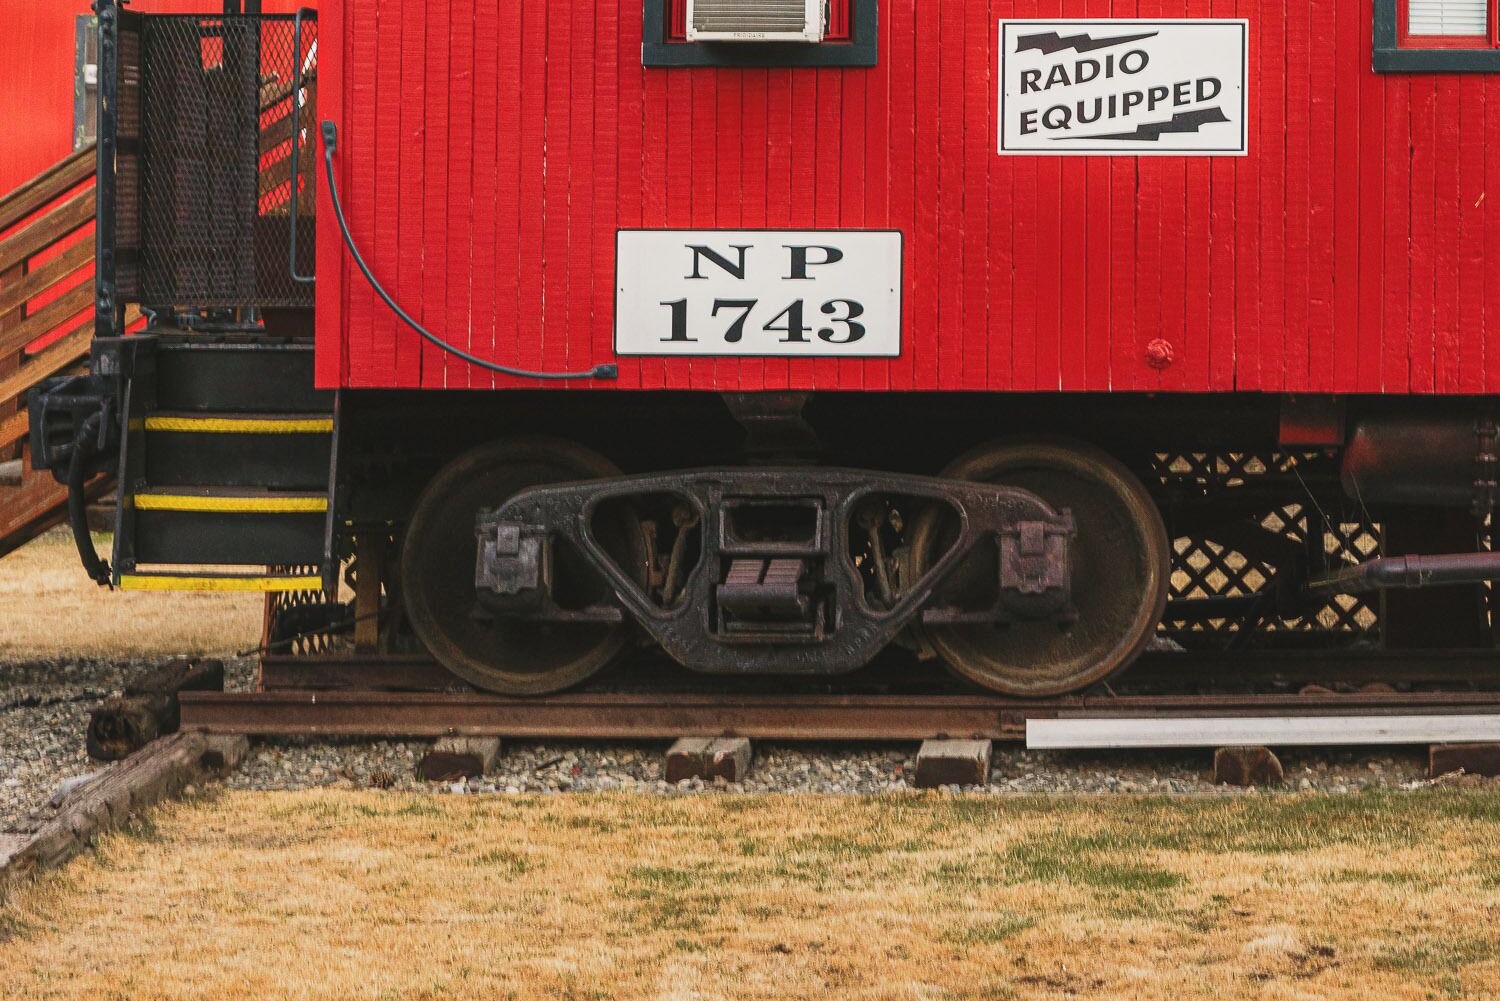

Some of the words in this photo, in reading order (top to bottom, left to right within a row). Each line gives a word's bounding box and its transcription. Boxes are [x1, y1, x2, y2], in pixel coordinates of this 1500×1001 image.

[1020, 49, 1150, 95] RADIO
[1019, 77, 1222, 136] EQUIPPED
[684, 245, 754, 280] N
[782, 245, 844, 280] P
[659, 298, 866, 344] 1743
